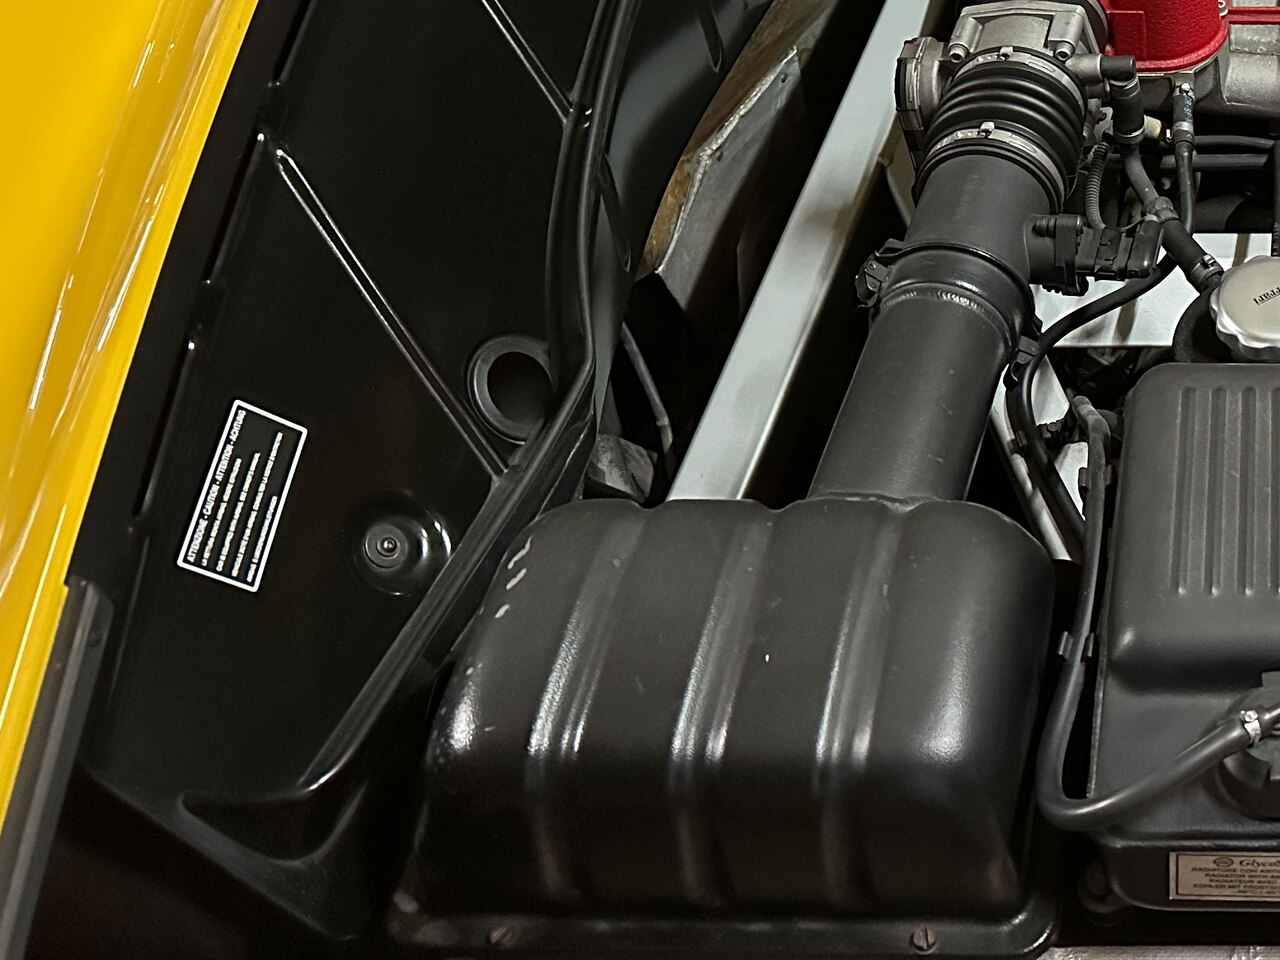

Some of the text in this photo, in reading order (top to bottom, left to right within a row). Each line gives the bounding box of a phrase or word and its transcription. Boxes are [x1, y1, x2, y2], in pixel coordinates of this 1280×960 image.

[186, 518, 208, 562] ATTENZIONE
[202, 483, 220, 515] CAUTION
[214, 444, 233, 481] ATTENTION
[229, 409, 247, 440] ACHTUNG
